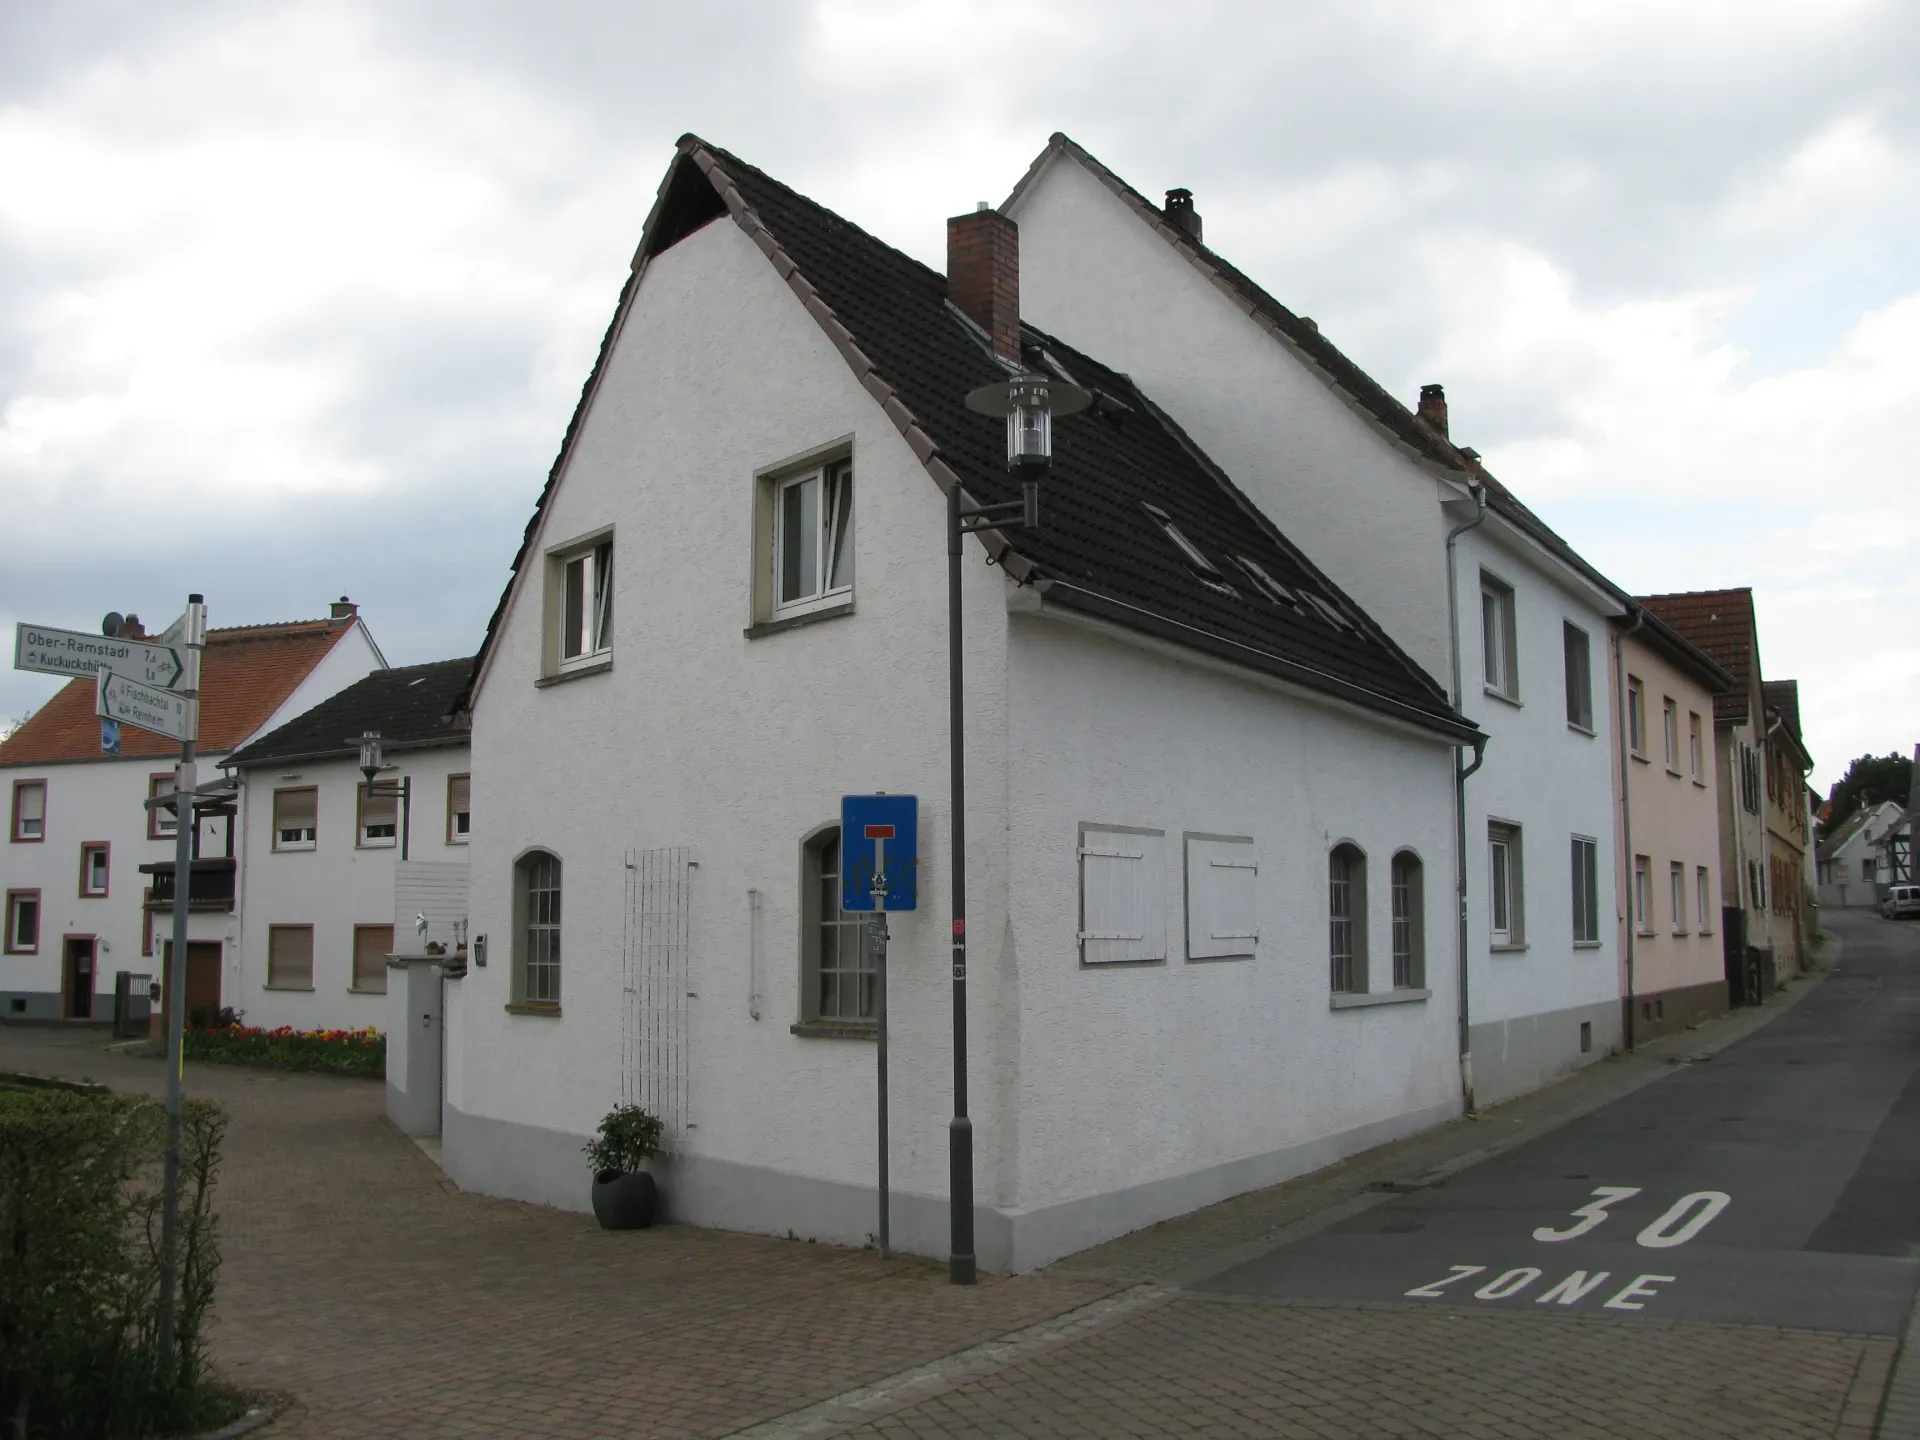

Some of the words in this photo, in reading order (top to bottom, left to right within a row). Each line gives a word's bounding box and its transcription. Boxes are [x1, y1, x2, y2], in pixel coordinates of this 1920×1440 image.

[27, 632, 130, 659] Ober-Ramstadt
[126, 685, 169, 711] Fischbachtal
[133, 705, 165, 727] Reinheim
[1533, 1187, 1731, 1248] 30
[1403, 1265, 1676, 1310] ZONE
